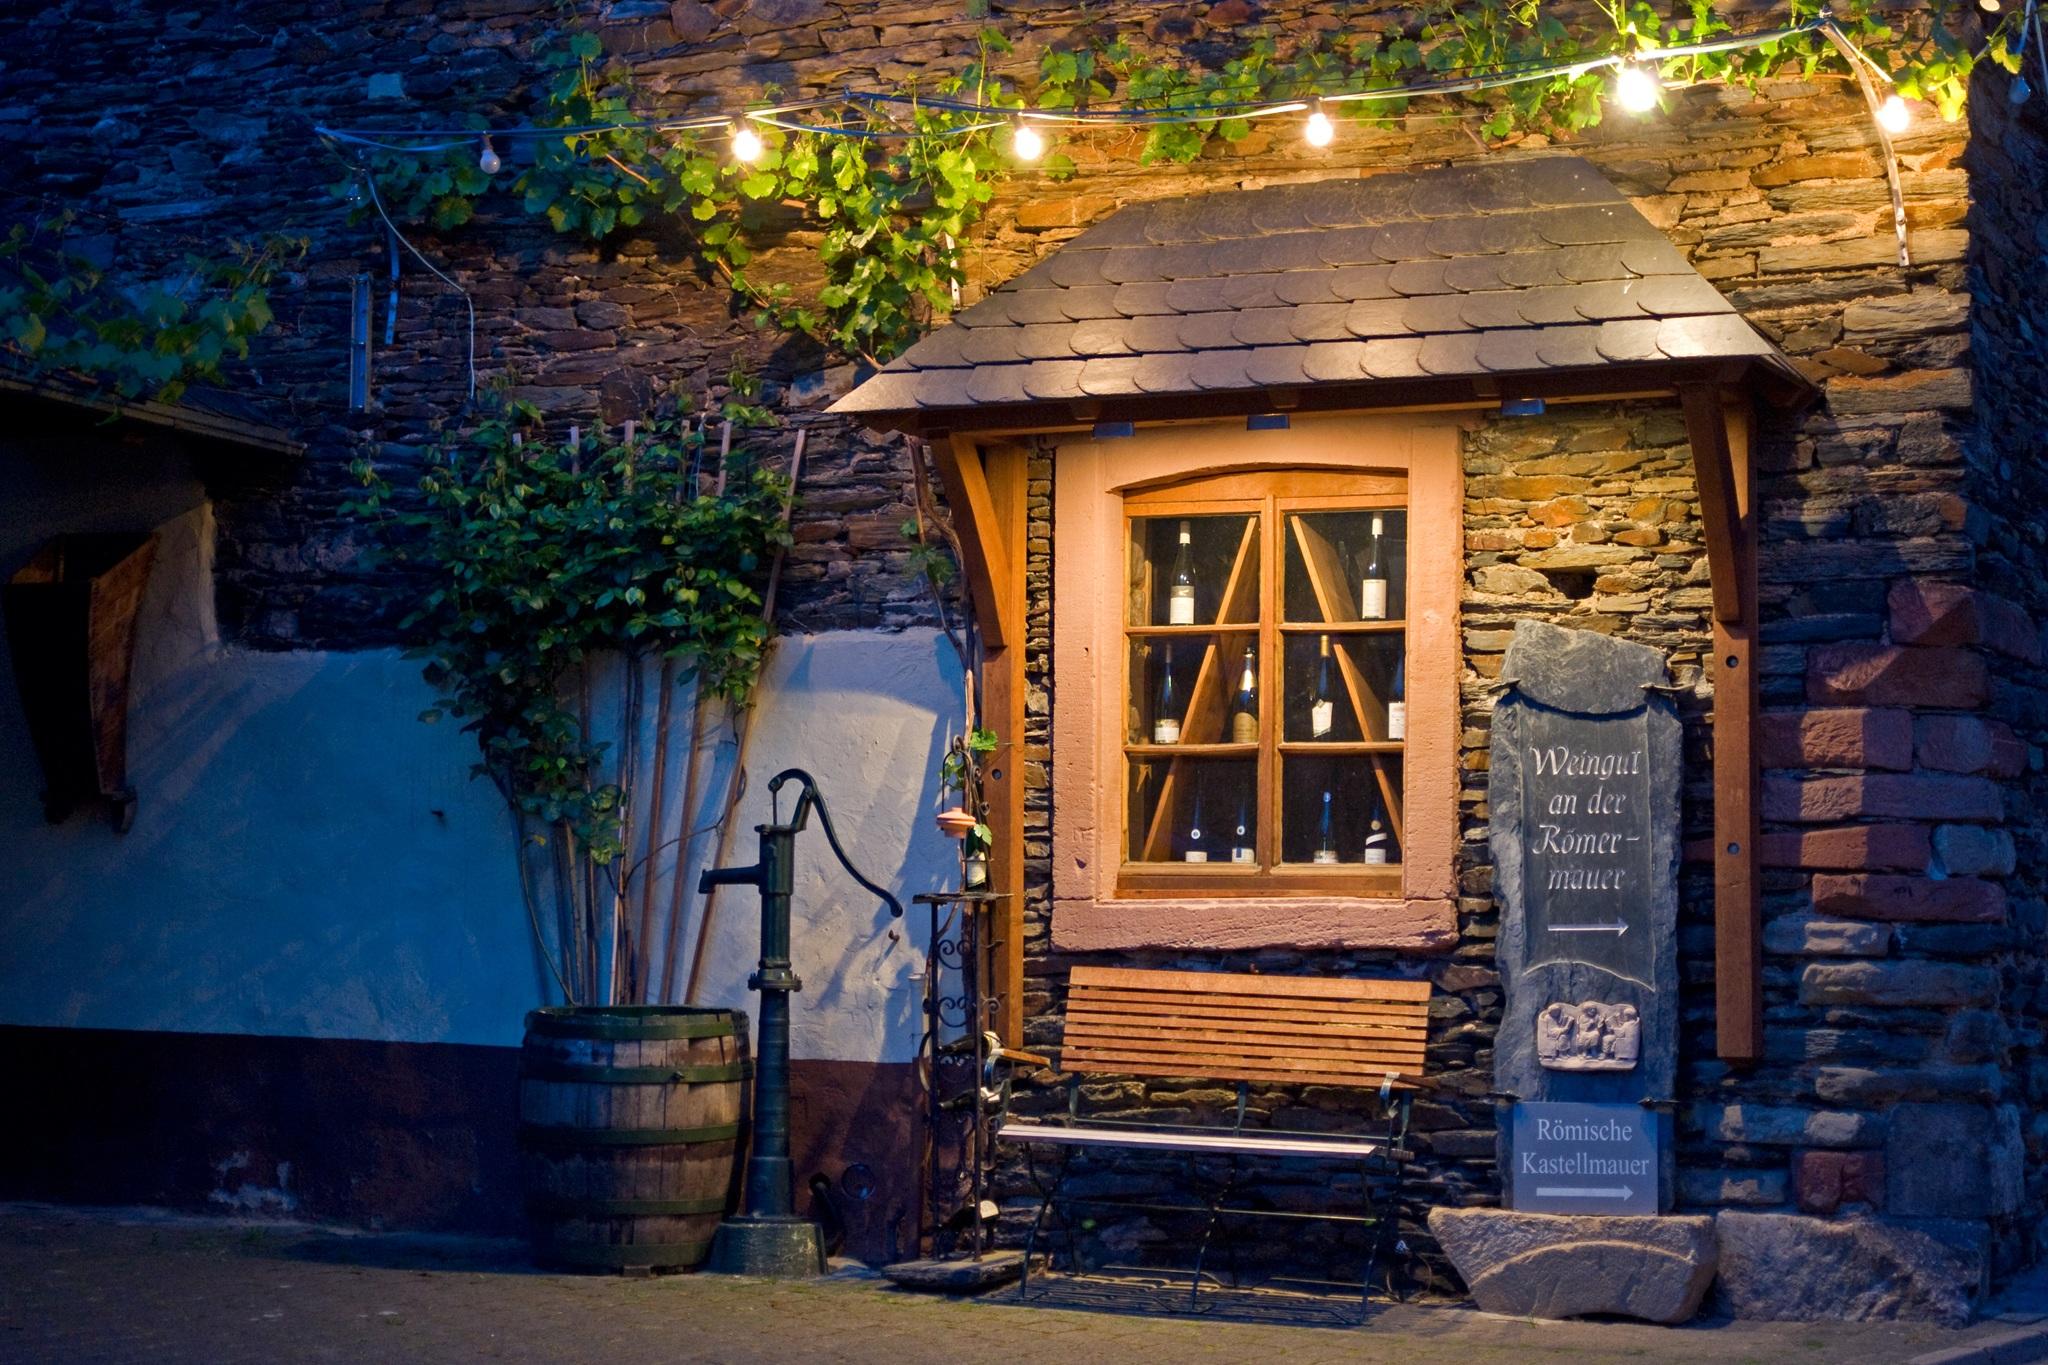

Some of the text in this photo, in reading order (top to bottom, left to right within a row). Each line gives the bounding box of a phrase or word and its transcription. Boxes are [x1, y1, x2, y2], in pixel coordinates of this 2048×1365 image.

[1529, 746, 1642, 781] Weingut
[1549, 786, 1627, 815] an der
[1532, 824, 1641, 855] Römer-
[1548, 867, 1626, 890] mauer
[1537, 1118, 1633, 1142] Römische
[1521, 1151, 1650, 1175] Kastellmauer
